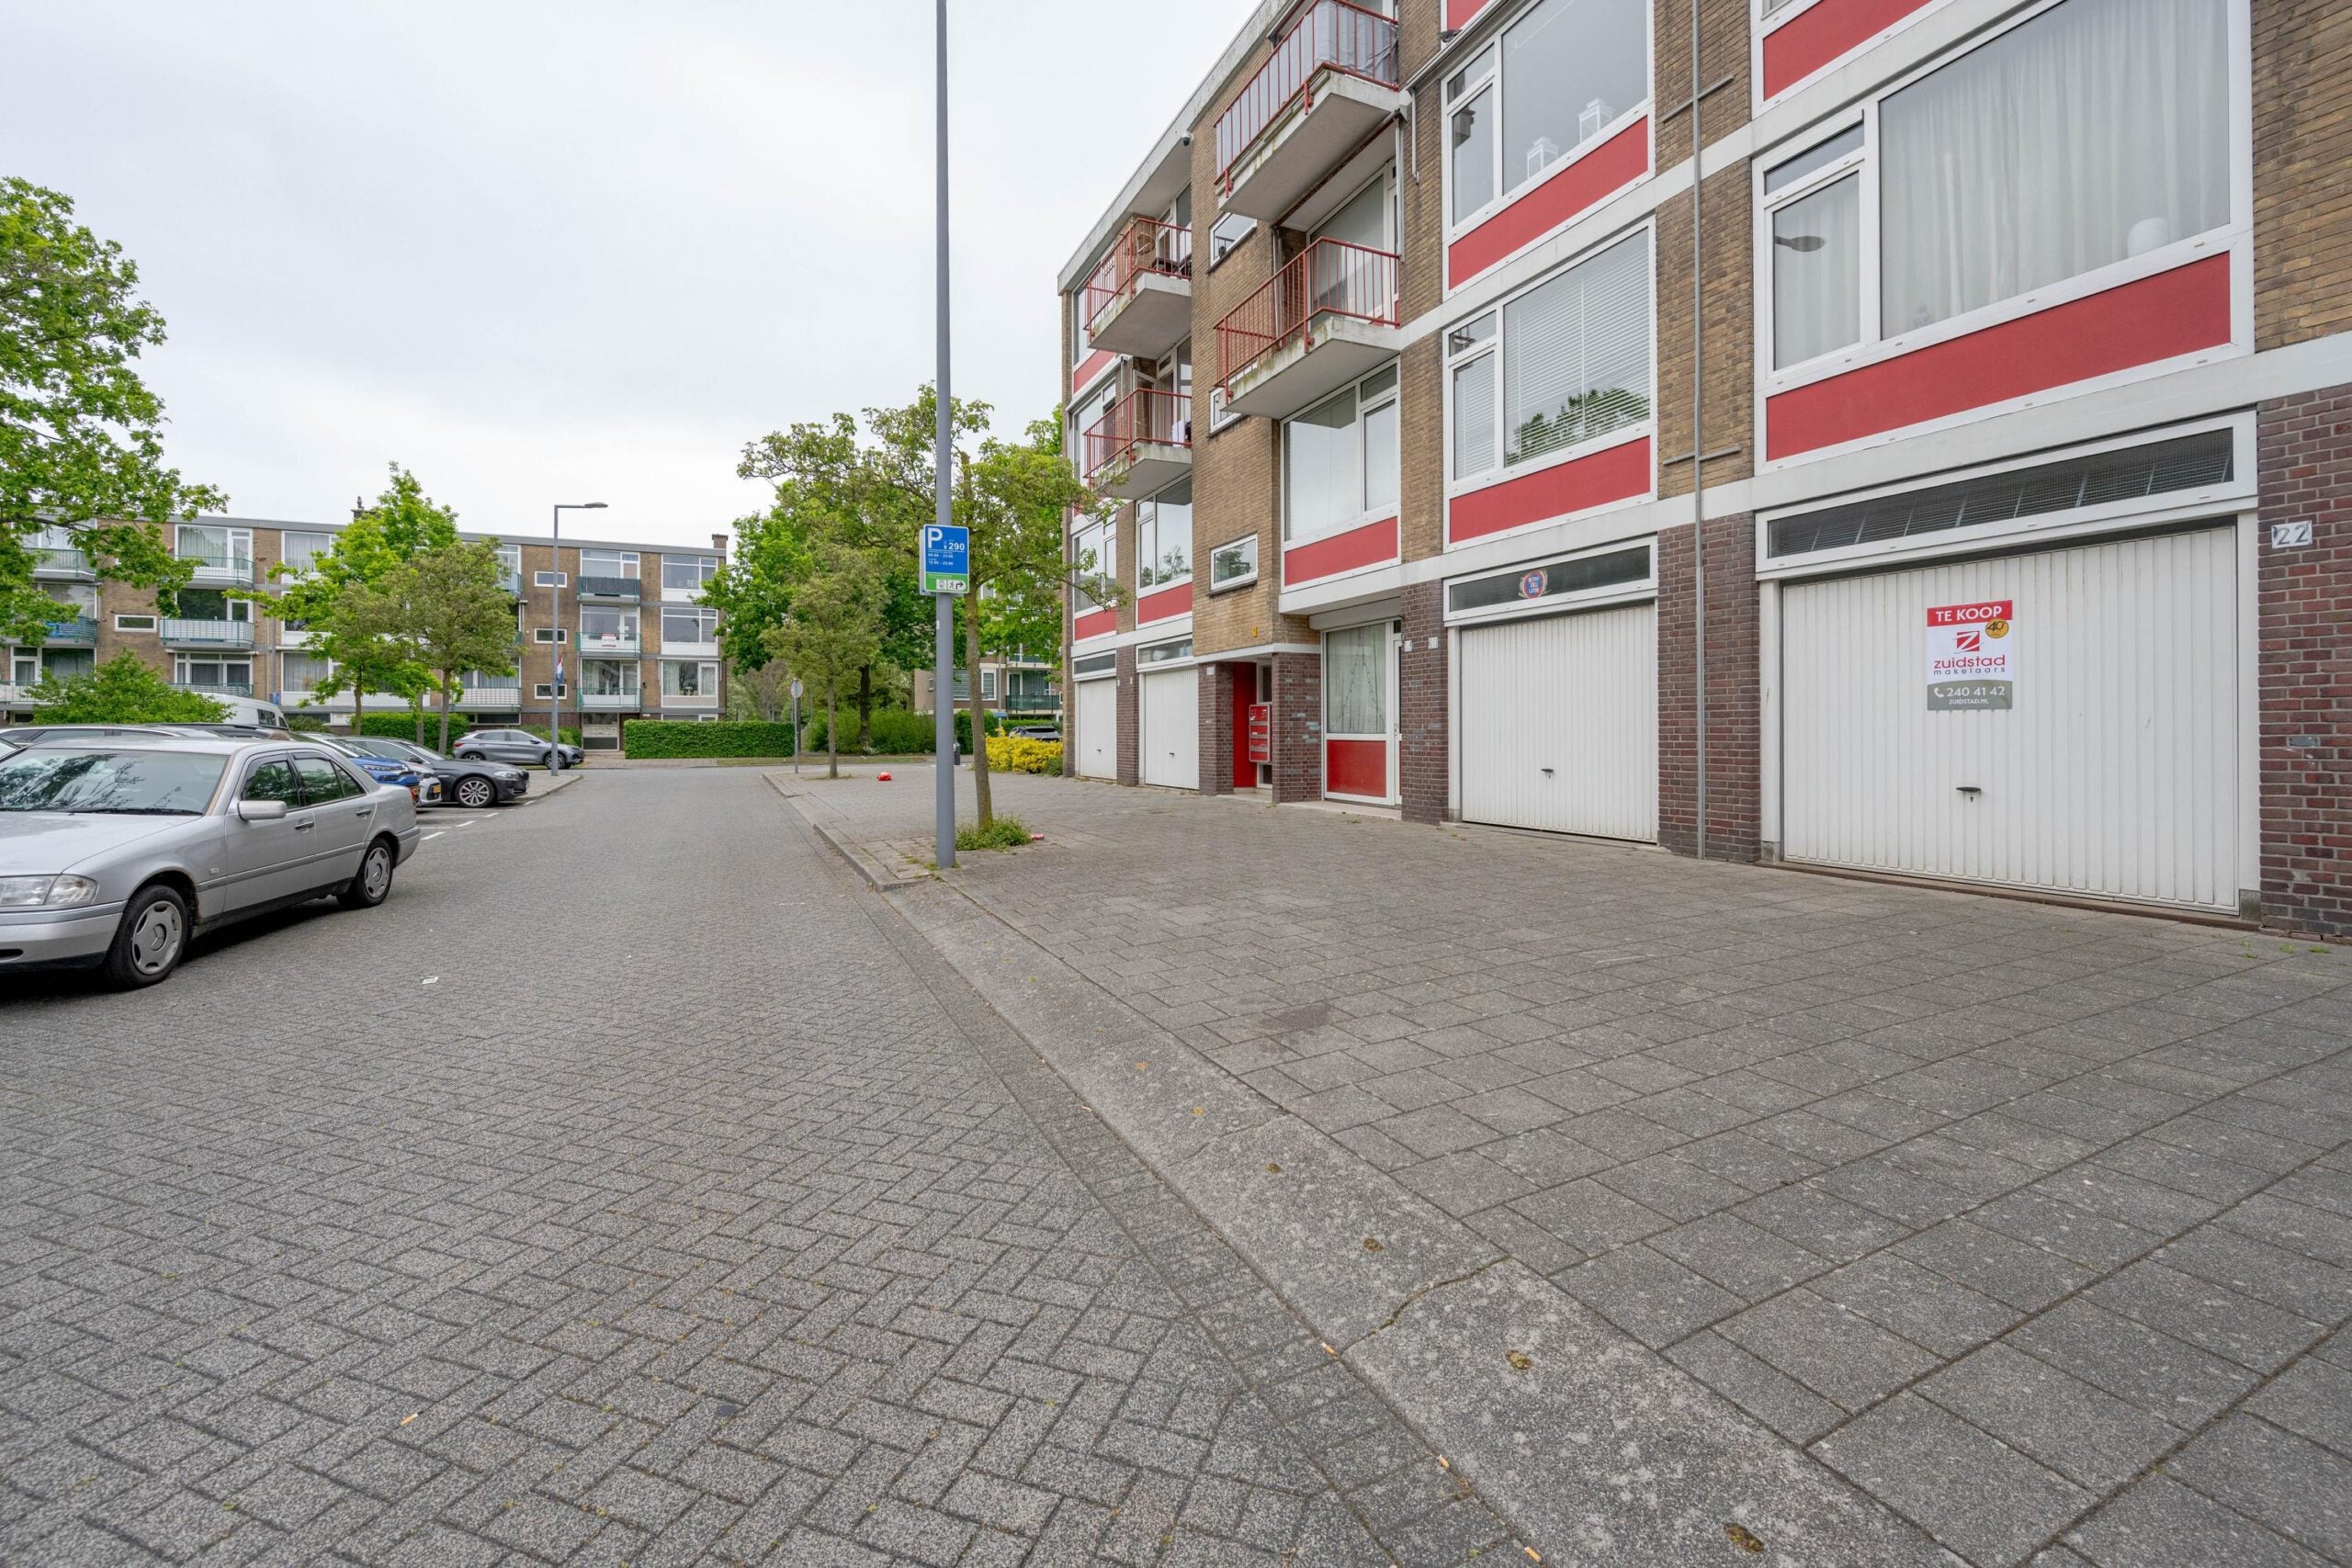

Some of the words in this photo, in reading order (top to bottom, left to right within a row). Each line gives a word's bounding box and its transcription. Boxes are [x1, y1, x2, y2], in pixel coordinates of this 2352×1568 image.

[928, 527, 943, 548] P
[948, 542, 965, 550] 290
[1936, 610, 1952, 622] TE
[1957, 606, 2002, 620] KOOP
[1934, 655, 2006, 669] zuidstad
[1947, 687, 1970, 697] 240
[1973, 687, 1985, 696] 41
[1990, 685, 2005, 695] 42
